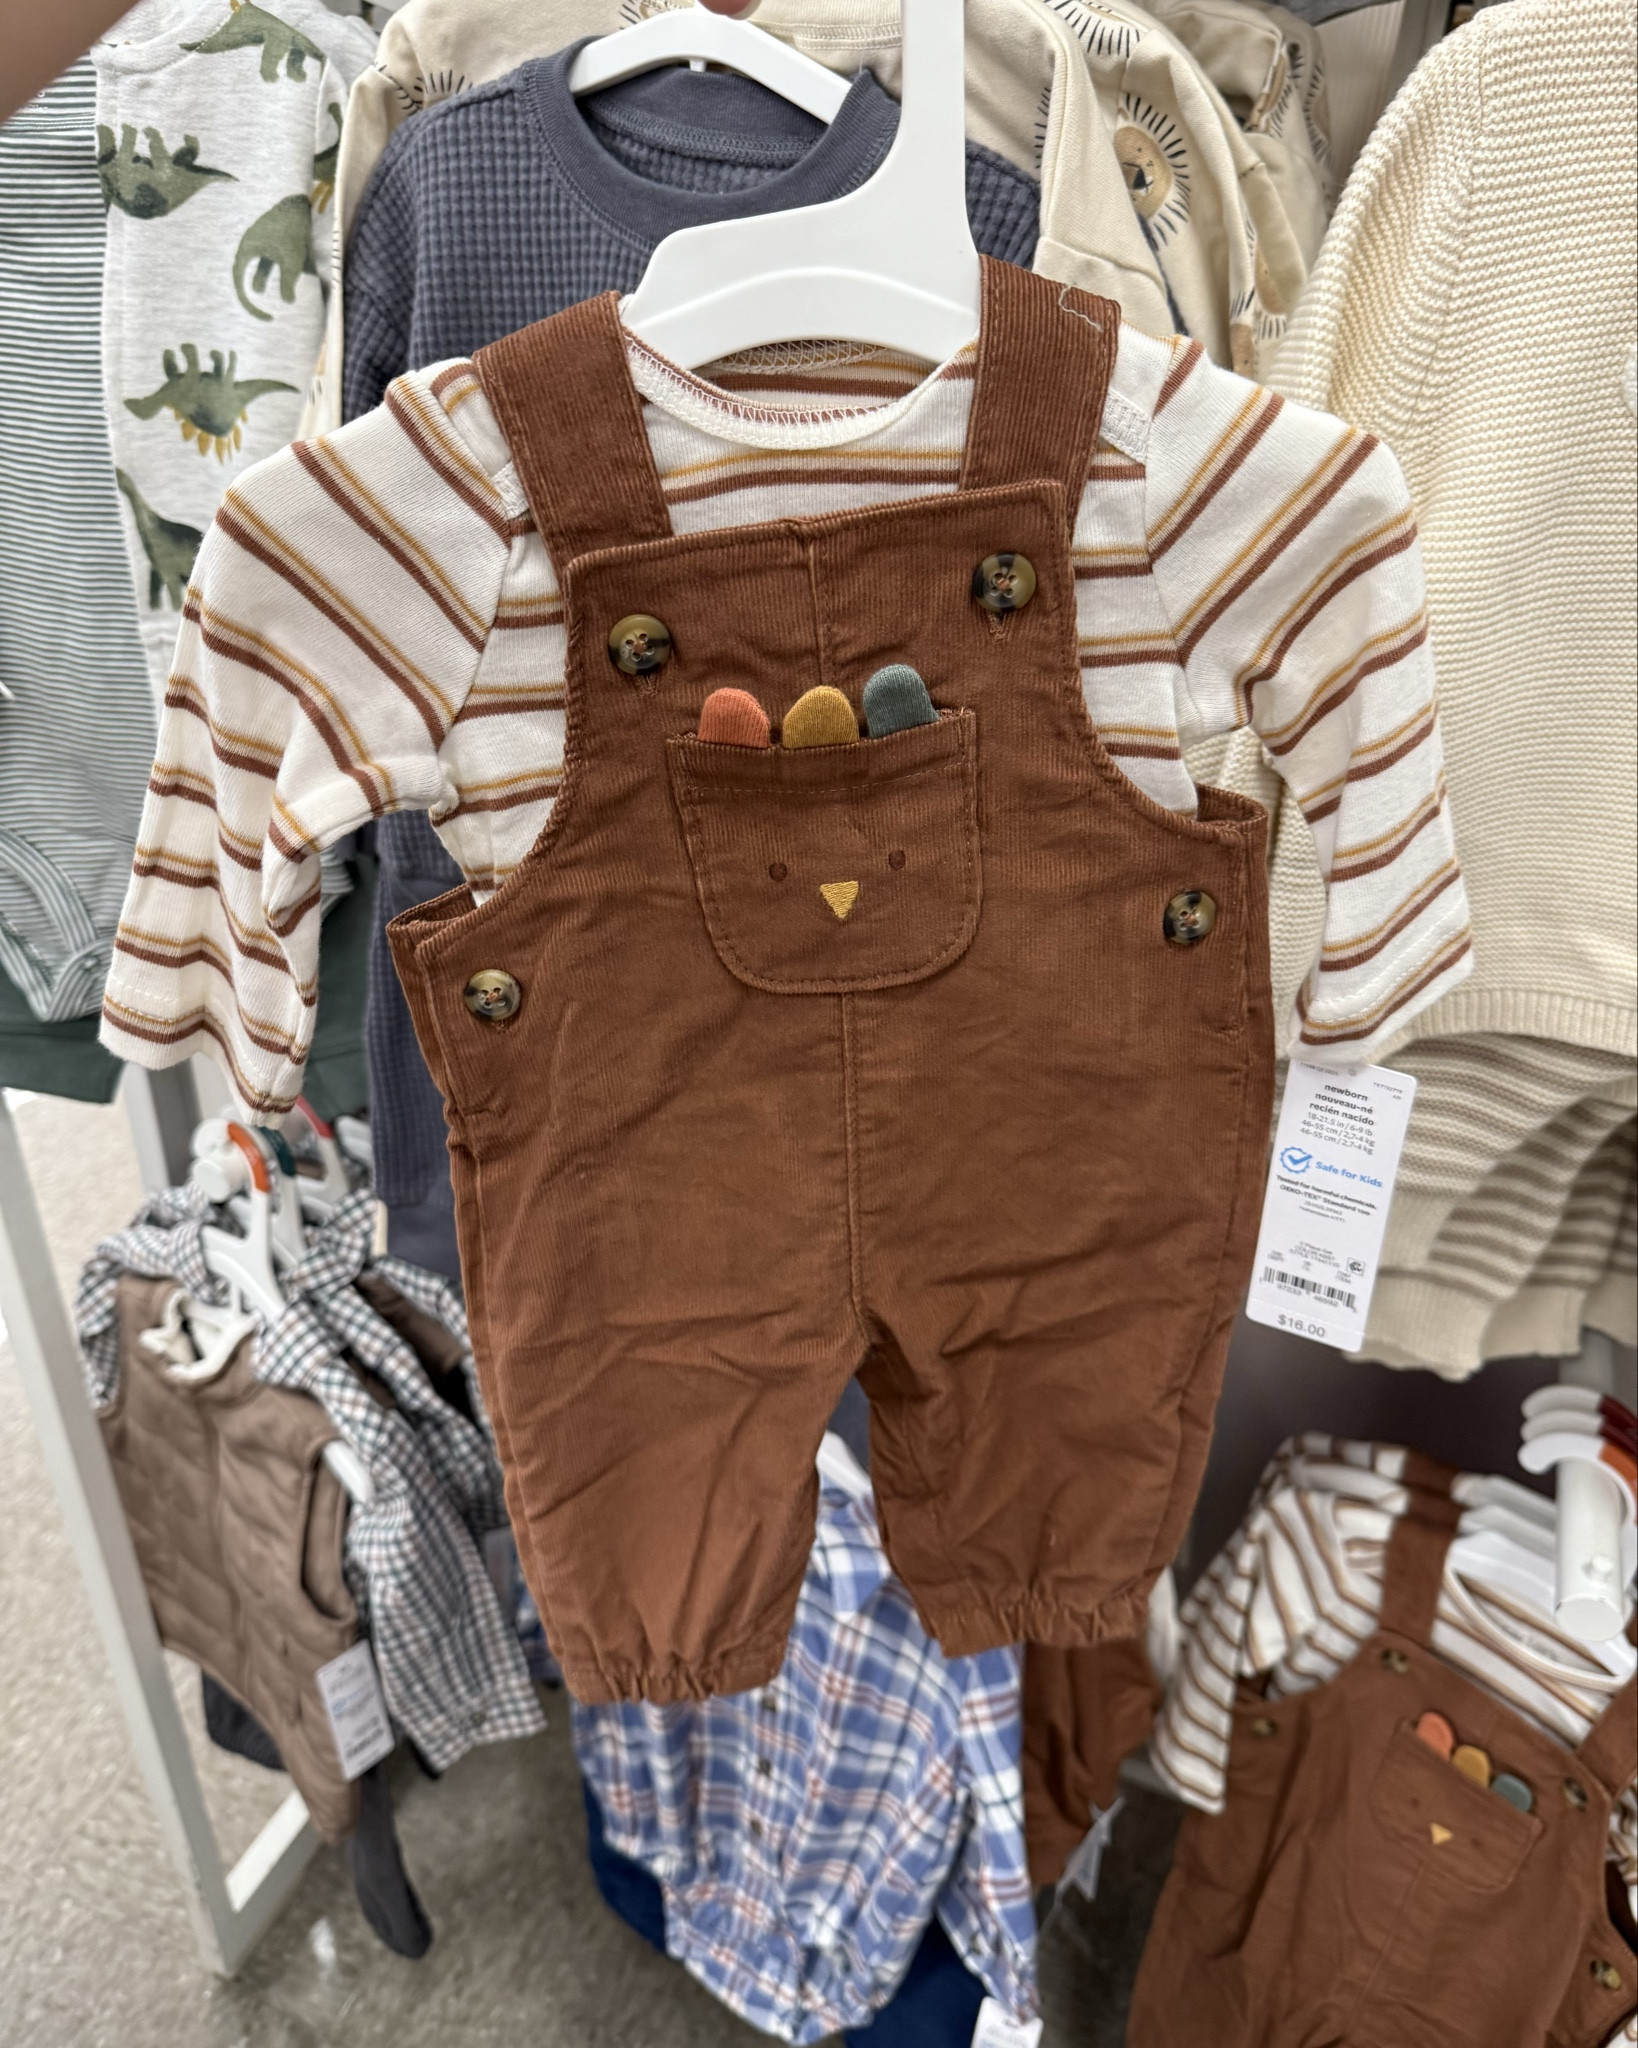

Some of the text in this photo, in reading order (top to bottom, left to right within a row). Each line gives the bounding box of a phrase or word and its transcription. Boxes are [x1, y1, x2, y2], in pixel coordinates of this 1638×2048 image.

[1315, 1092, 1373, 1115] nouveau-né
[1324, 1083, 1368, 1101] newborn
[1308, 1112, 1336, 1125] 18-21.5
[1337, 1120, 1346, 1129] in
[1350, 1124, 1364, 1133] 6-9
[1365, 1127, 1373, 1136] lb
[1309, 1102, 1375, 1126] recién nacido
[1300, 1127, 1323, 1139] 46-55
[1323, 1134, 1337, 1143] cm
[1363, 1144, 1373, 1156] kg
[1301, 1119, 1325, 1131] 46-55
[1325, 1125, 1338, 1135] cm
[1365, 1136, 1375, 1147] kg
[1316, 1161, 1383, 1188] Safe for Kids
[1276, 1175, 1299, 1186] Tested
[1300, 1181, 1311, 1189] for
[1311, 1185, 1339, 1198] harmful
[1323, 1197, 1356, 1212] Standard
[1277, 1314, 1326, 1337] $16.00
